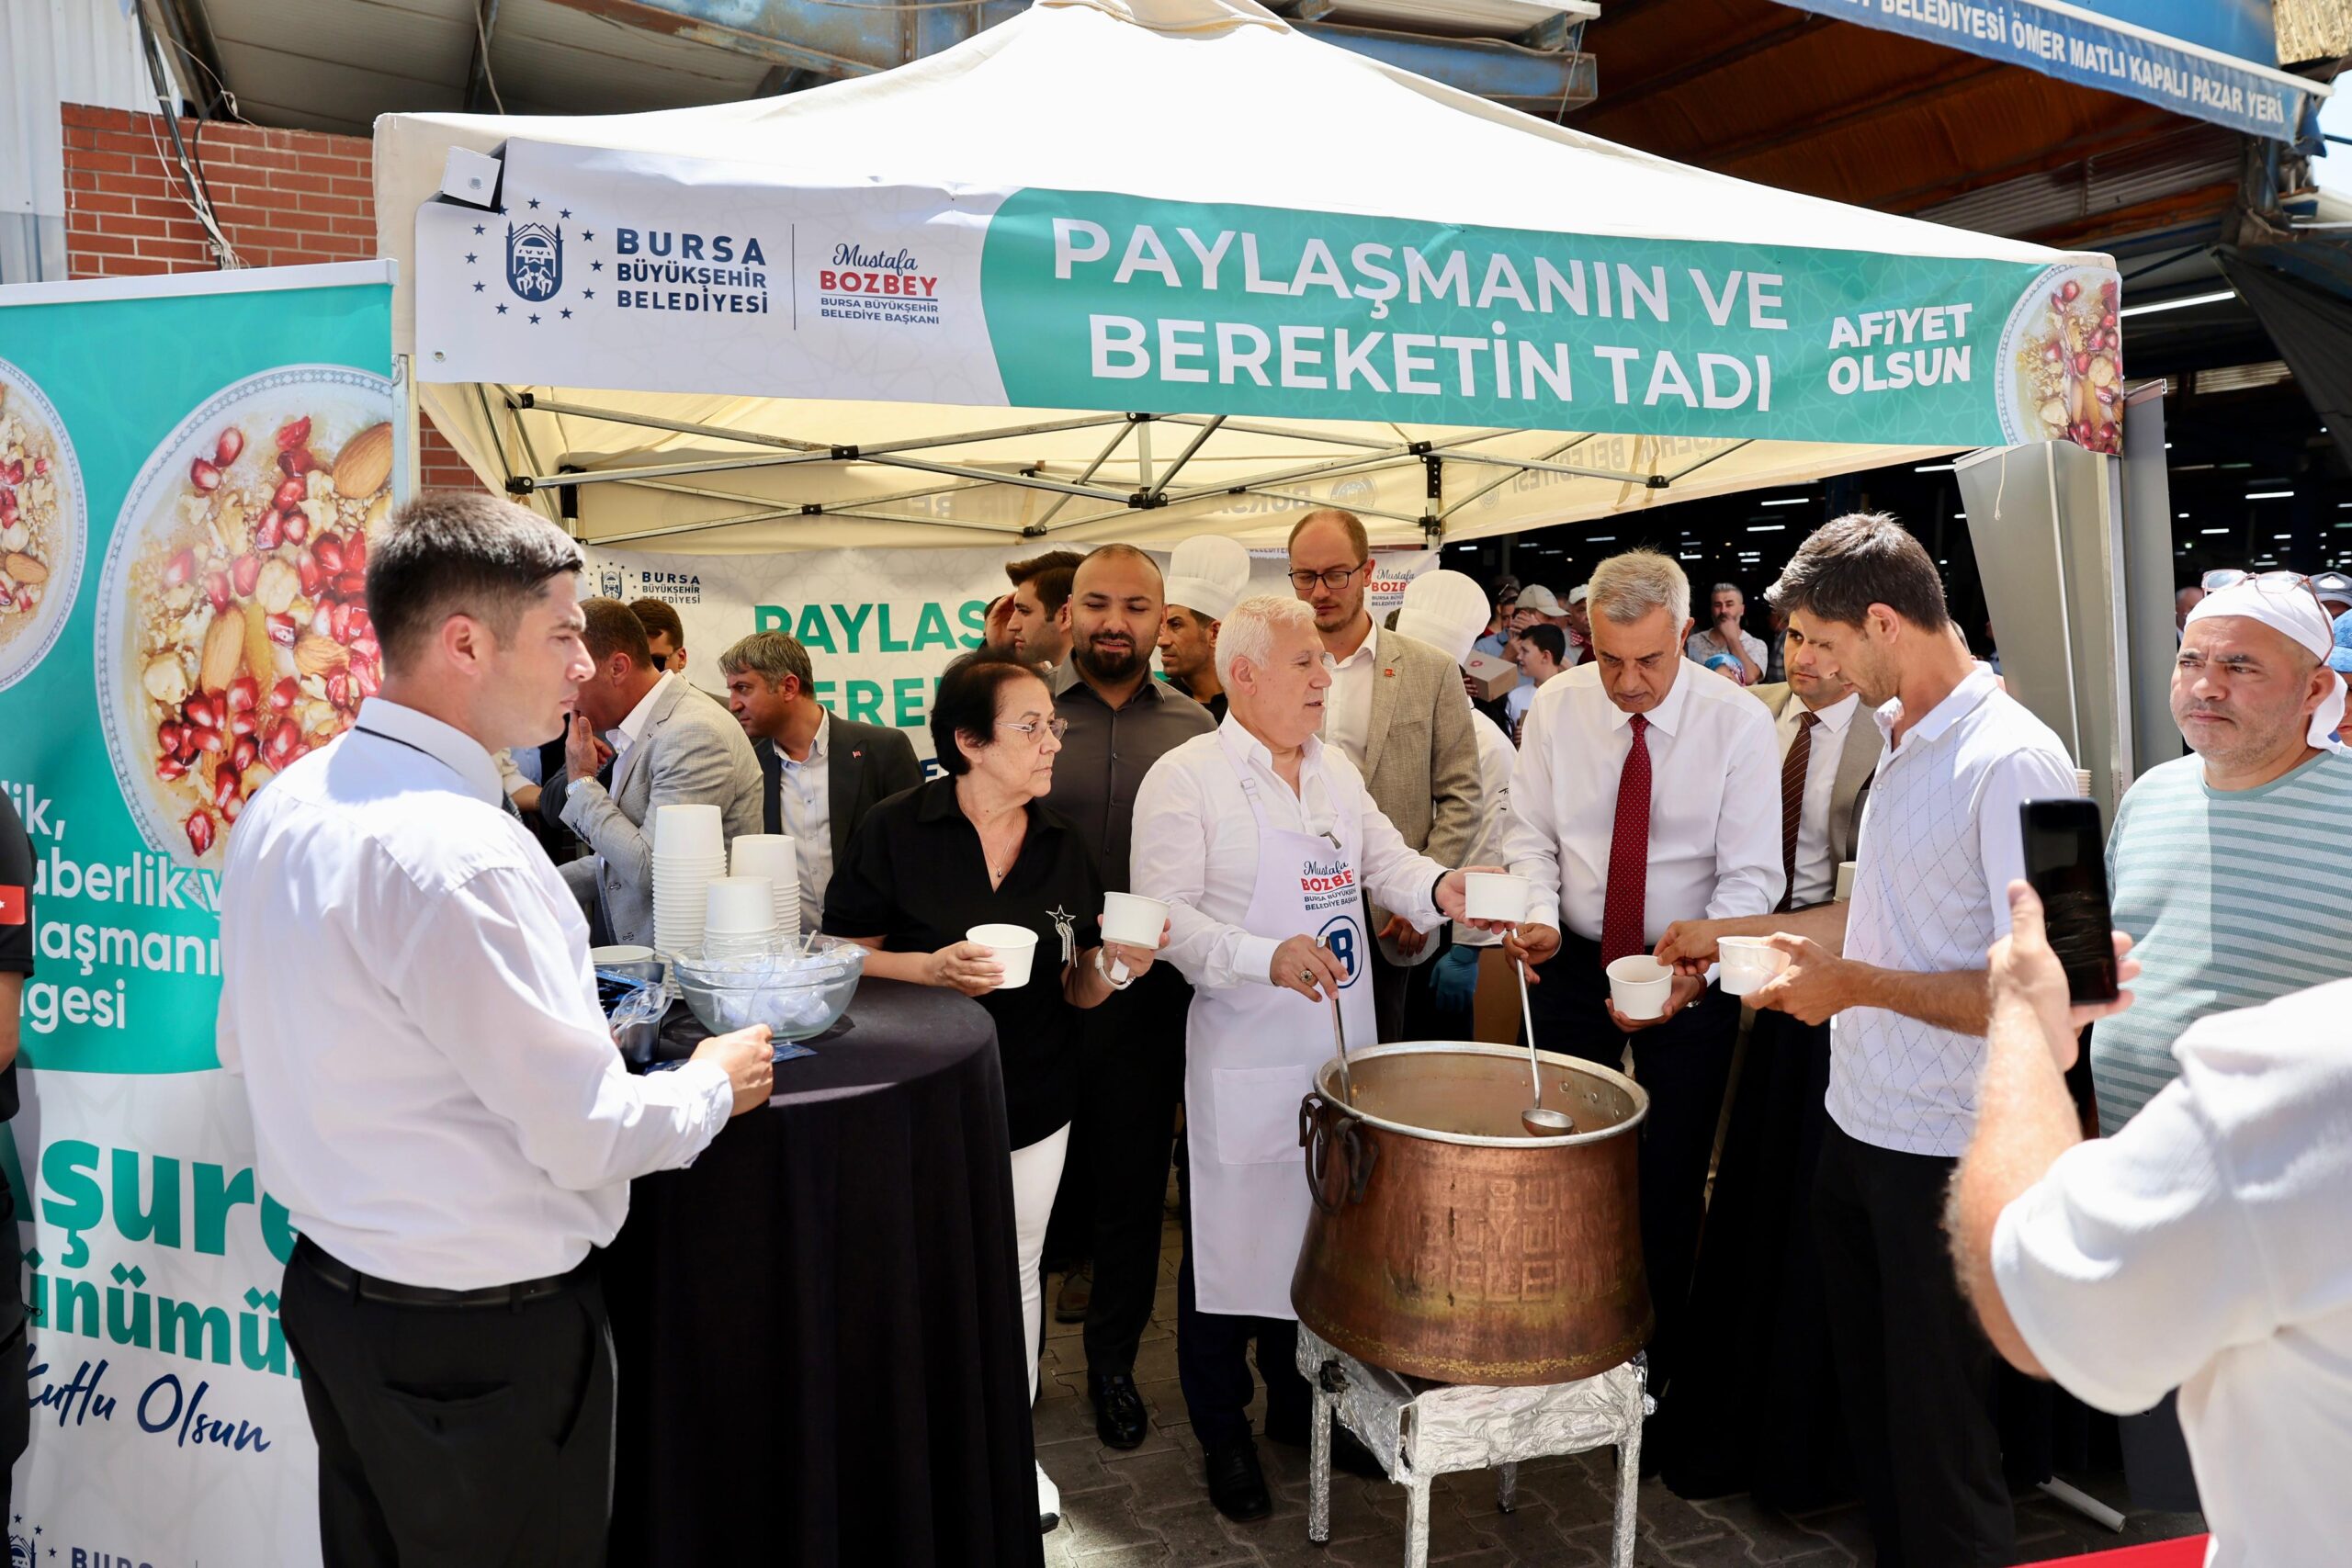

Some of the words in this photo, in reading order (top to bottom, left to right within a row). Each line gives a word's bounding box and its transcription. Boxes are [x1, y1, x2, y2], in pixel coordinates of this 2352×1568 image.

[2012, 12, 2065, 62] ÖMER
[2070, 37, 2126, 78] MATLI
[2130, 55, 2188, 98] KAPALI
[2192, 76, 2243, 113] PAZAR
[2247, 91, 2284, 123] YERİ
[617, 228, 766, 265] BURSA
[833, 243, 918, 276] Mustafa
[617, 258, 766, 288] BÜYÜKŞEHİR
[820, 271, 937, 297] BOZBEY
[1052, 218, 1668, 321] PAYLAŞMANIN
[1689, 268, 1788, 330] VE
[617, 288, 767, 313] BELEDİYESİ
[820, 298, 862, 308] BURSA
[865, 299, 938, 313] BÜYÜKŞEHİR
[821, 309, 881, 321] BELEDİYE
[885, 313, 939, 324] BAŞKANI
[1090, 314, 1572, 401] BEREKETİN
[1594, 345, 1770, 412] TADI
[1828, 345, 1971, 394] OLSUN
[642, 571, 700, 584] BURSA
[642, 584, 700, 594] BÜYÜKŞEHİR
[1372, 582, 1406, 592] BOZB
[1377, 570, 1415, 583] Mustafa
[1301, 870, 1354, 892] BOZBE
[1304, 861, 1348, 875] Mustafa
[1306, 900, 1340, 910] BELEDİYE
[32, 905, 220, 976] aşmanı
[20, 979, 124, 1033] gesi
[22, 1247, 300, 1380] nümü
[137, 1373, 271, 1452] Olsun
